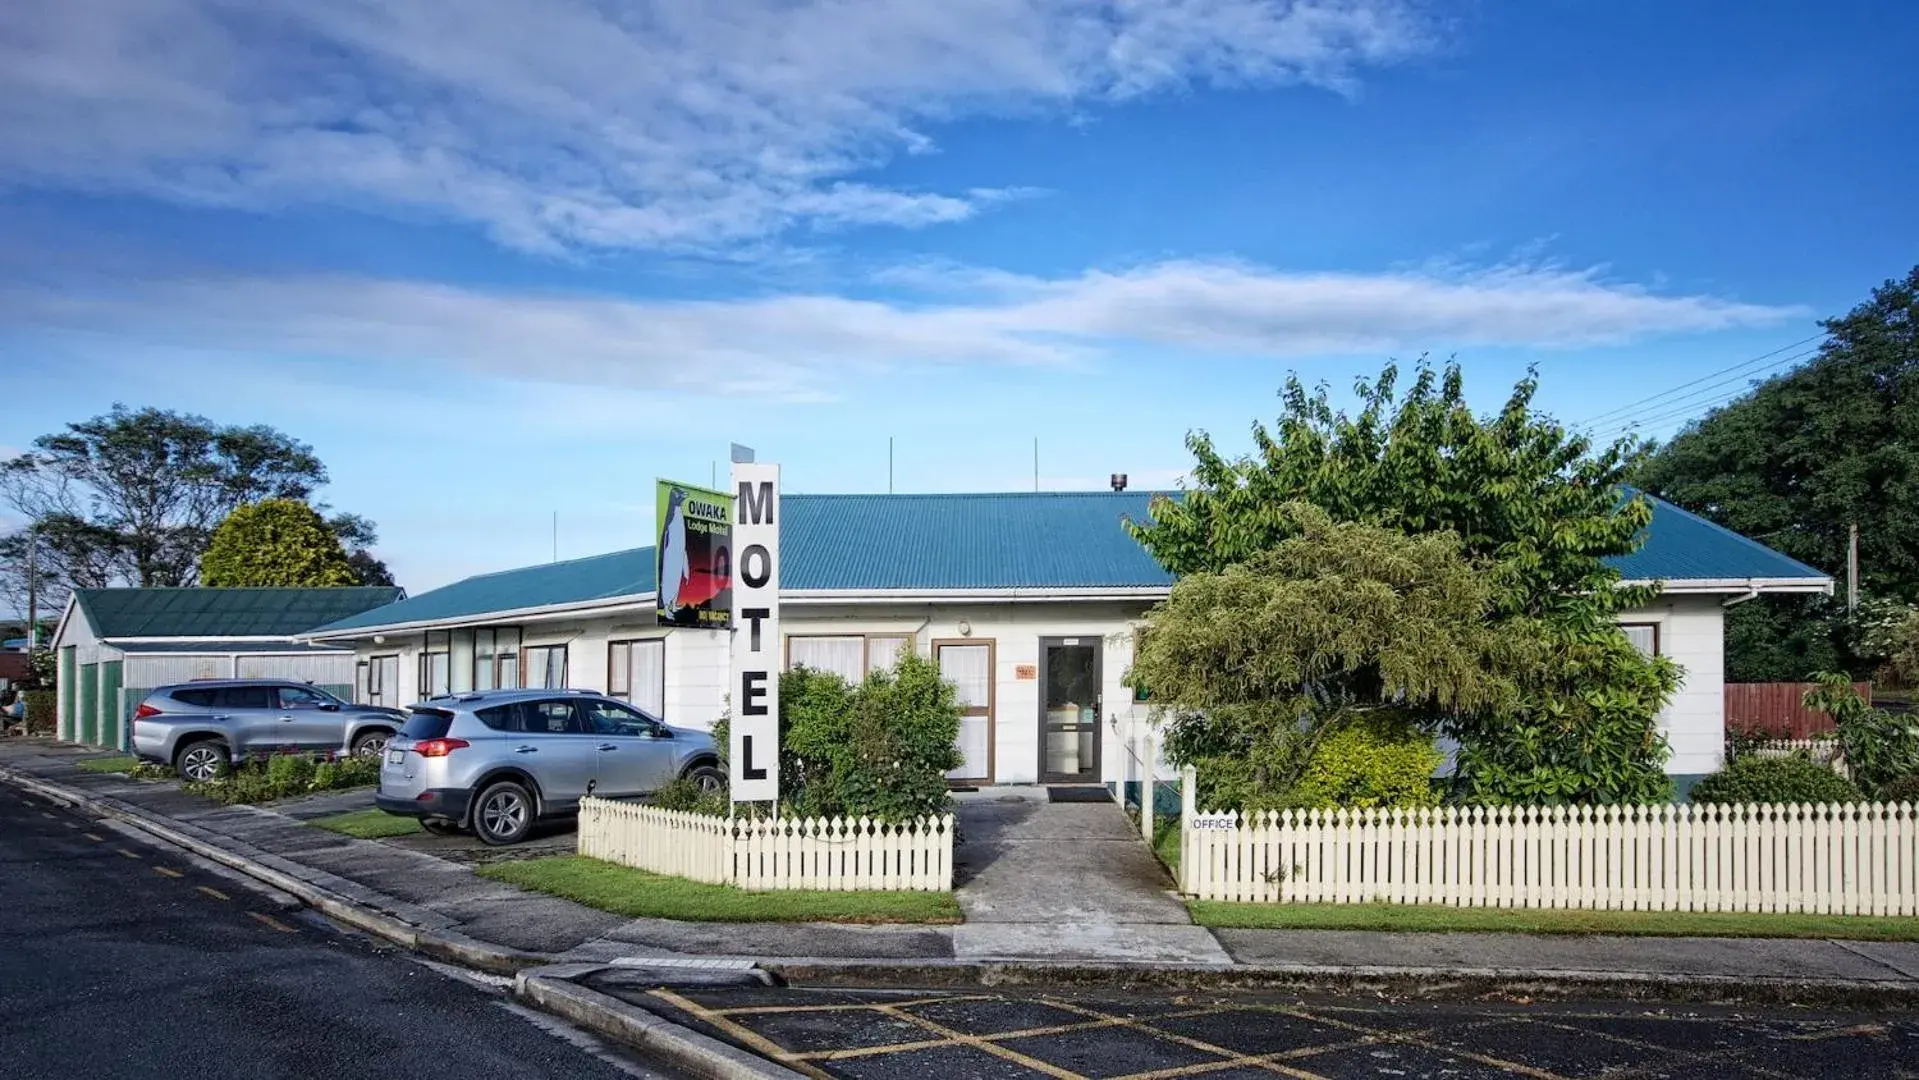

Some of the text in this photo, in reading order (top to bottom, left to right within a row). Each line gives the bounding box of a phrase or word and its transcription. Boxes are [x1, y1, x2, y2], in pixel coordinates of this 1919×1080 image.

[688, 500, 727, 521] OWAKA
[687, 520, 708, 535] Lodge
[738, 481, 773, 779] MOTEL
[1193, 819, 1233, 829] OFFICE
